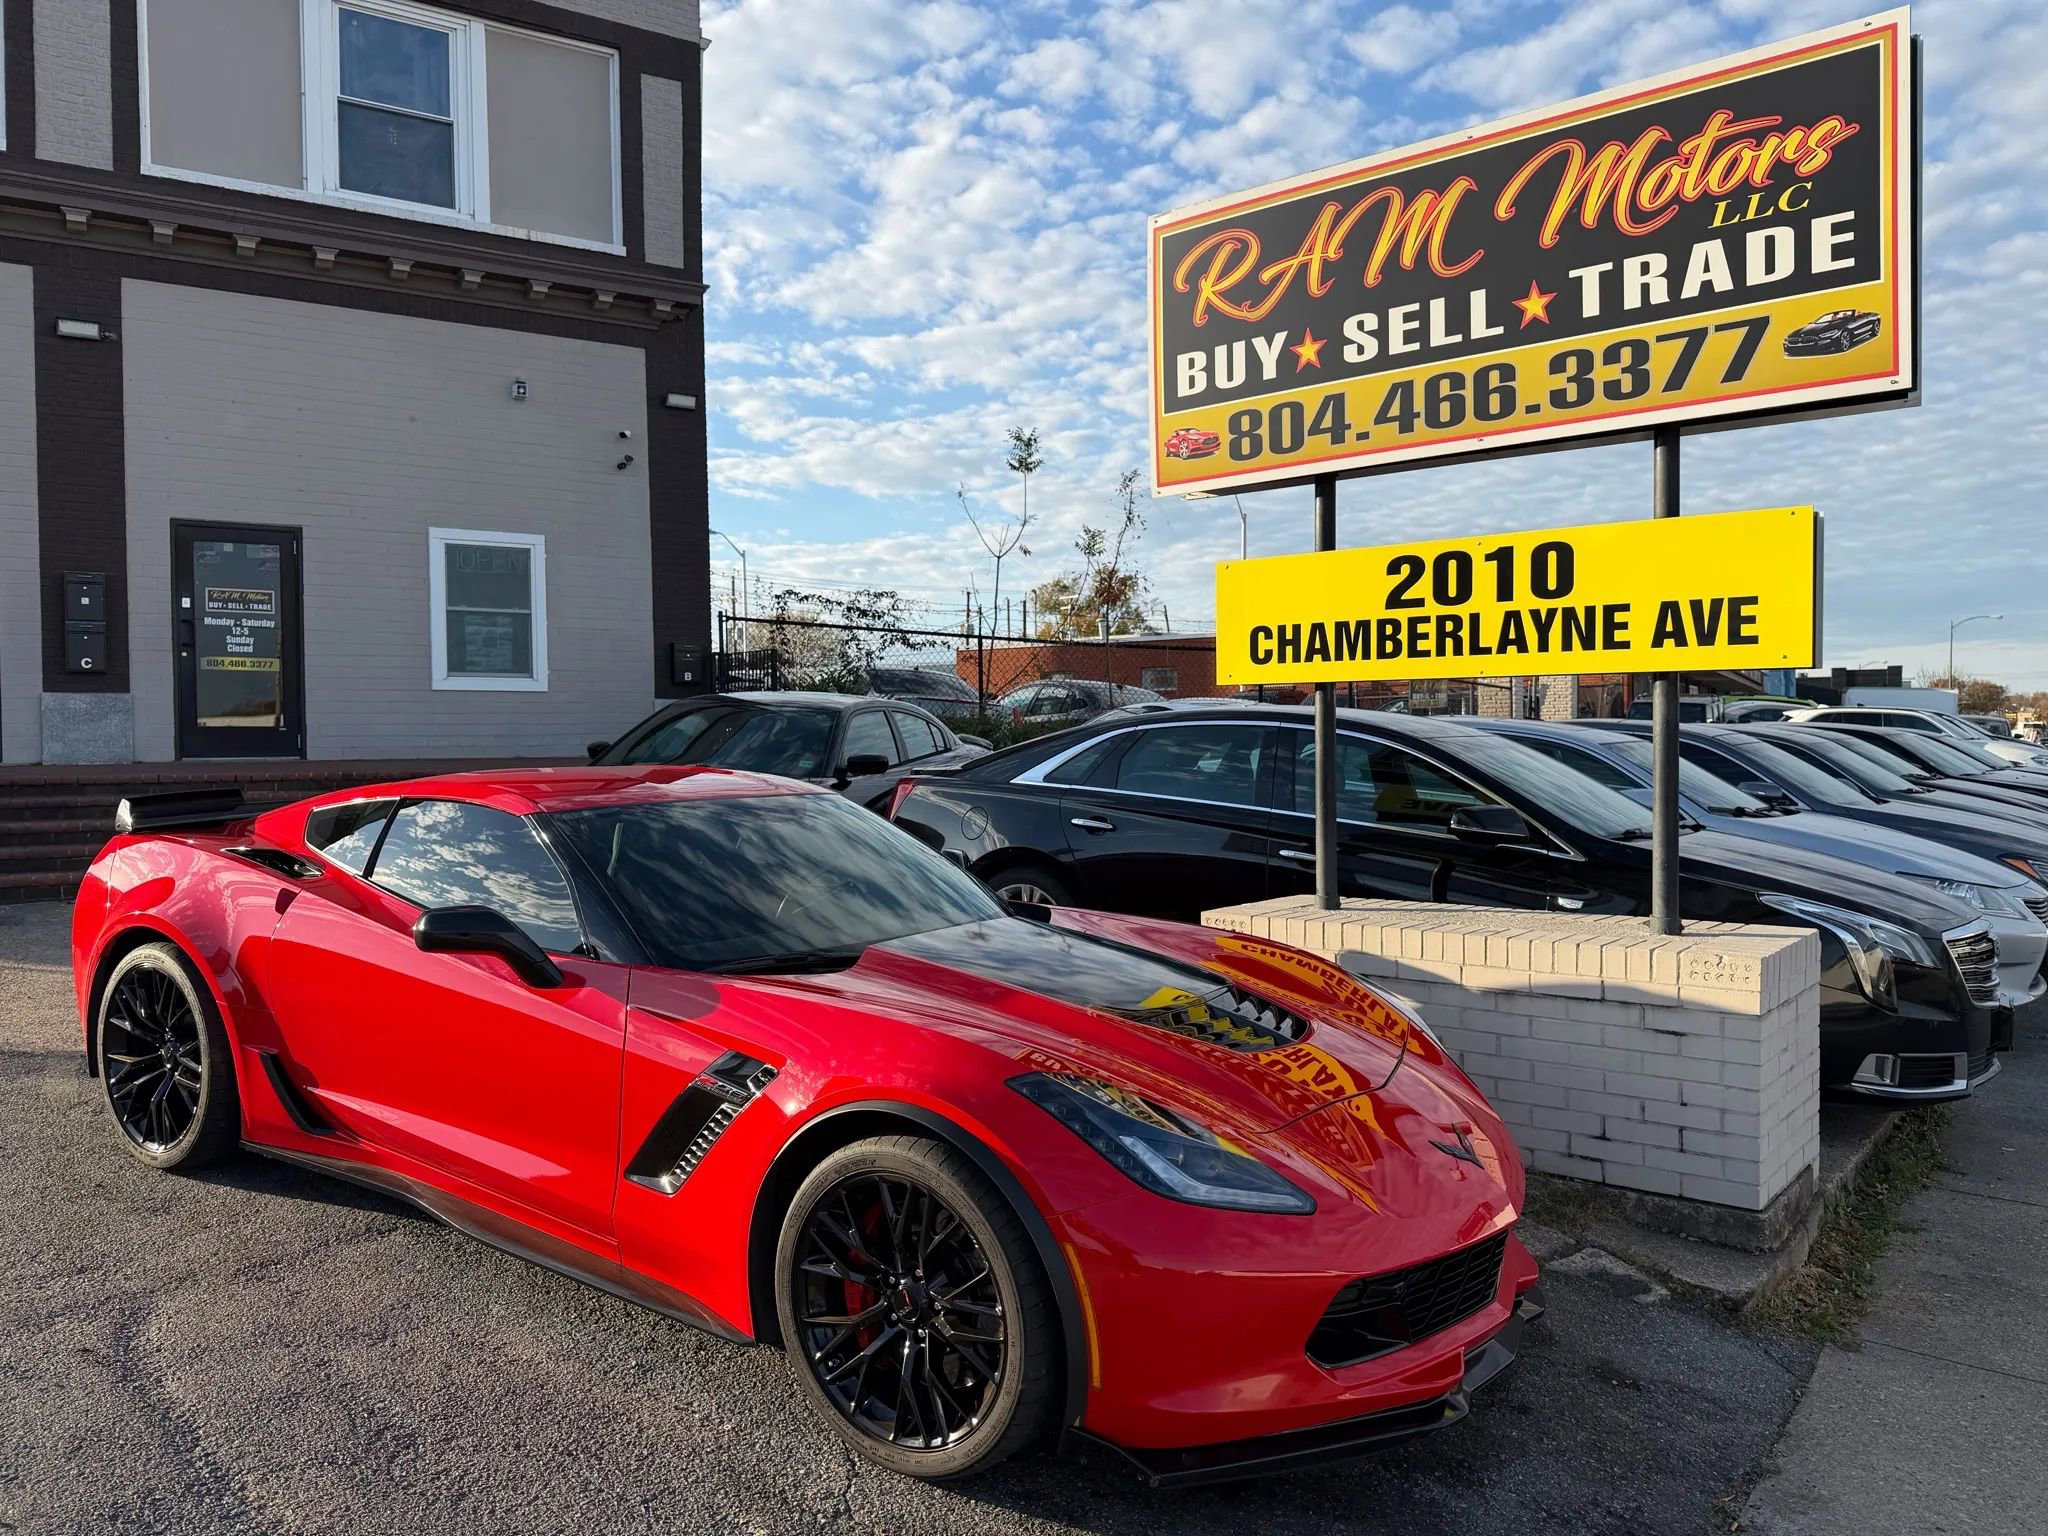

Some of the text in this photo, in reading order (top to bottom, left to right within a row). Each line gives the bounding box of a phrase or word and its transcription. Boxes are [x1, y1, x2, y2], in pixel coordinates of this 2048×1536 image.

[1707, 182, 1813, 229] LLC
[1173, 108, 1860, 327] RAM Motors
[1177, 210, 1855, 398] BUY SELL TRADE
[1228, 313, 1772, 462] 804.466.3377
[460, 550, 523, 572] OPEN
[1384, 540, 1575, 611] 2010
[227, 602, 244, 610] SELL
[249, 603, 272, 611] TRADE
[204, 617, 235, 626] Monday
[241, 618, 275, 628] Saturday
[232, 627, 249, 635] 12-5
[1248, 595, 1759, 666] CHAMBERLAYNE AVE
[226, 635, 255, 644] Sunday
[227, 644, 253, 653] Closed
[80, 657, 93, 669] C
[684, 672, 692, 681] B
